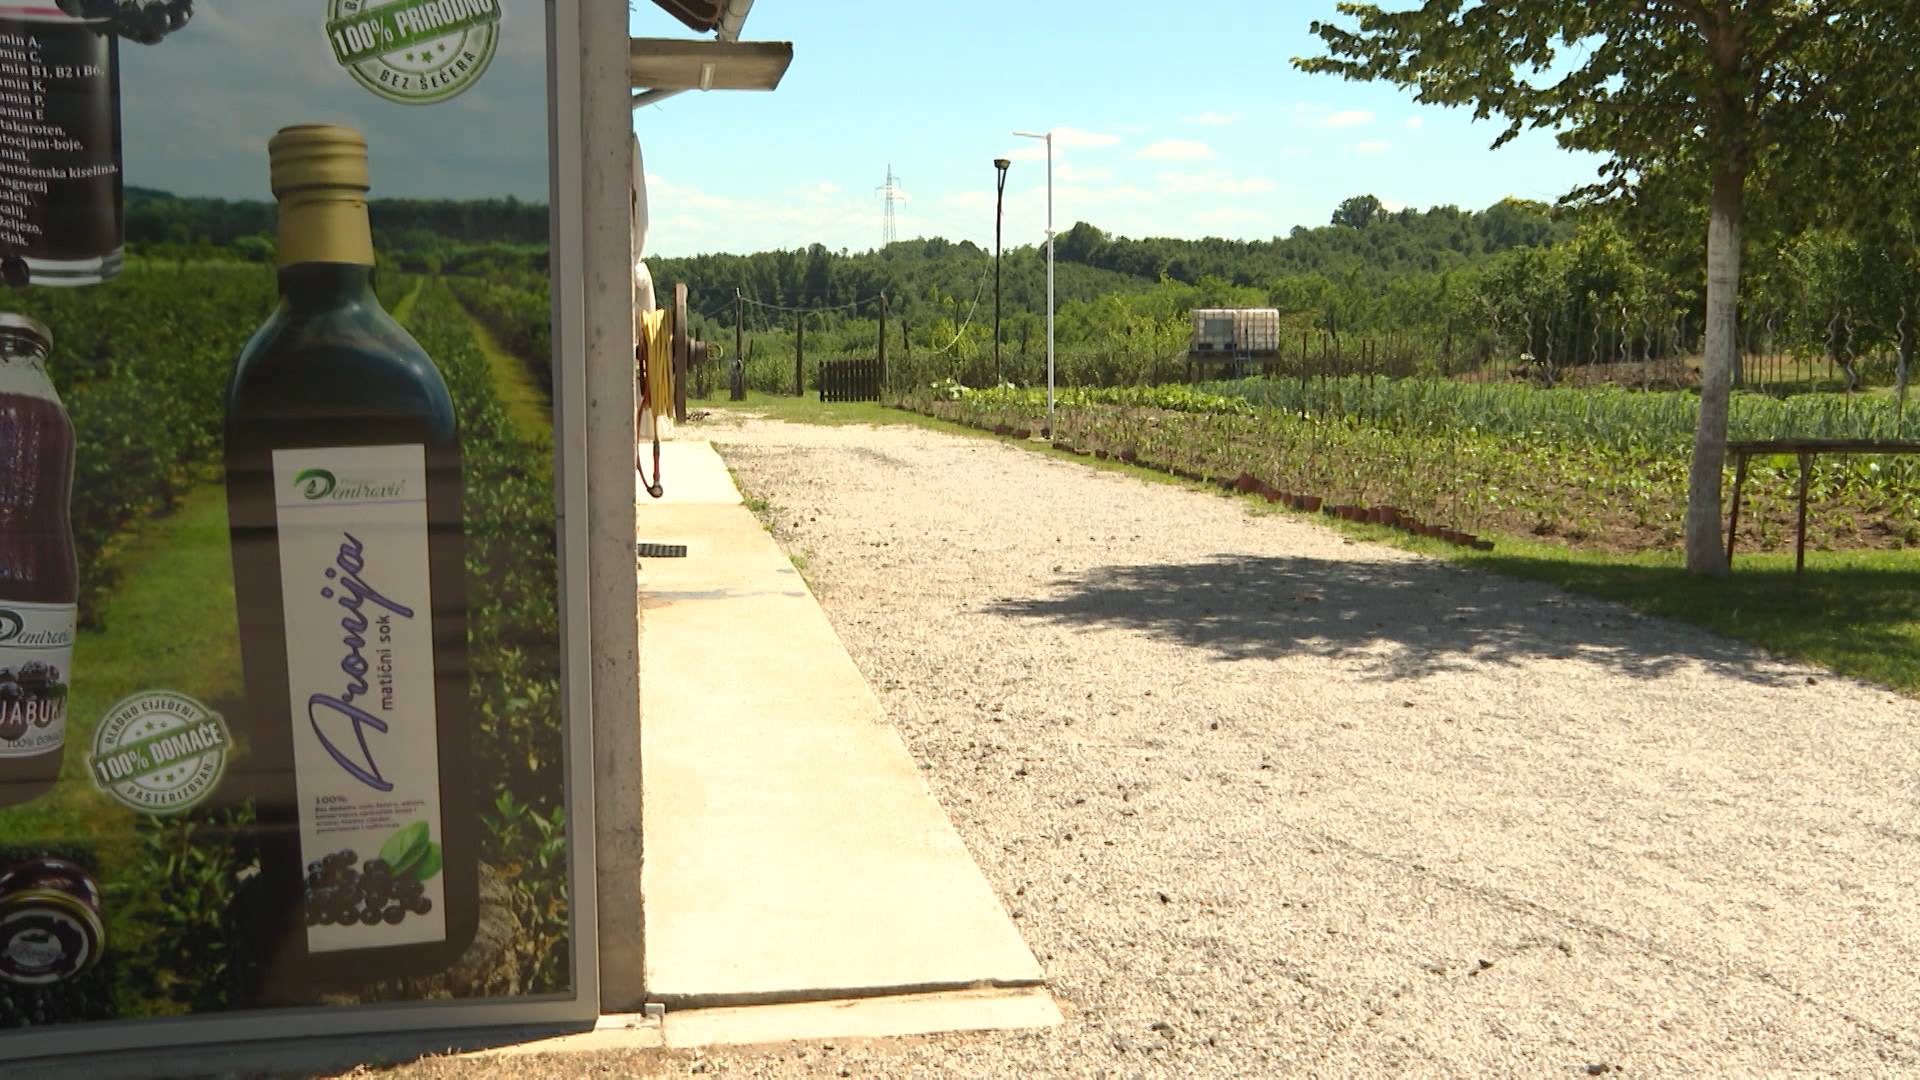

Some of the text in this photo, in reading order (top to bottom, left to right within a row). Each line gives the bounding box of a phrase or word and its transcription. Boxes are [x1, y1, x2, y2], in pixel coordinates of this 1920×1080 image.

[333, 16, 394, 56] 100%
[31, 65, 53, 79] B1,
[55, 66, 73, 78] B2
[379, 69, 409, 90] BEZ
[308, 532, 414, 792] Aronija
[376, 615, 393, 711] matični sok
[97, 748, 149, 782] 100%
[315, 795, 347, 804] 100%
